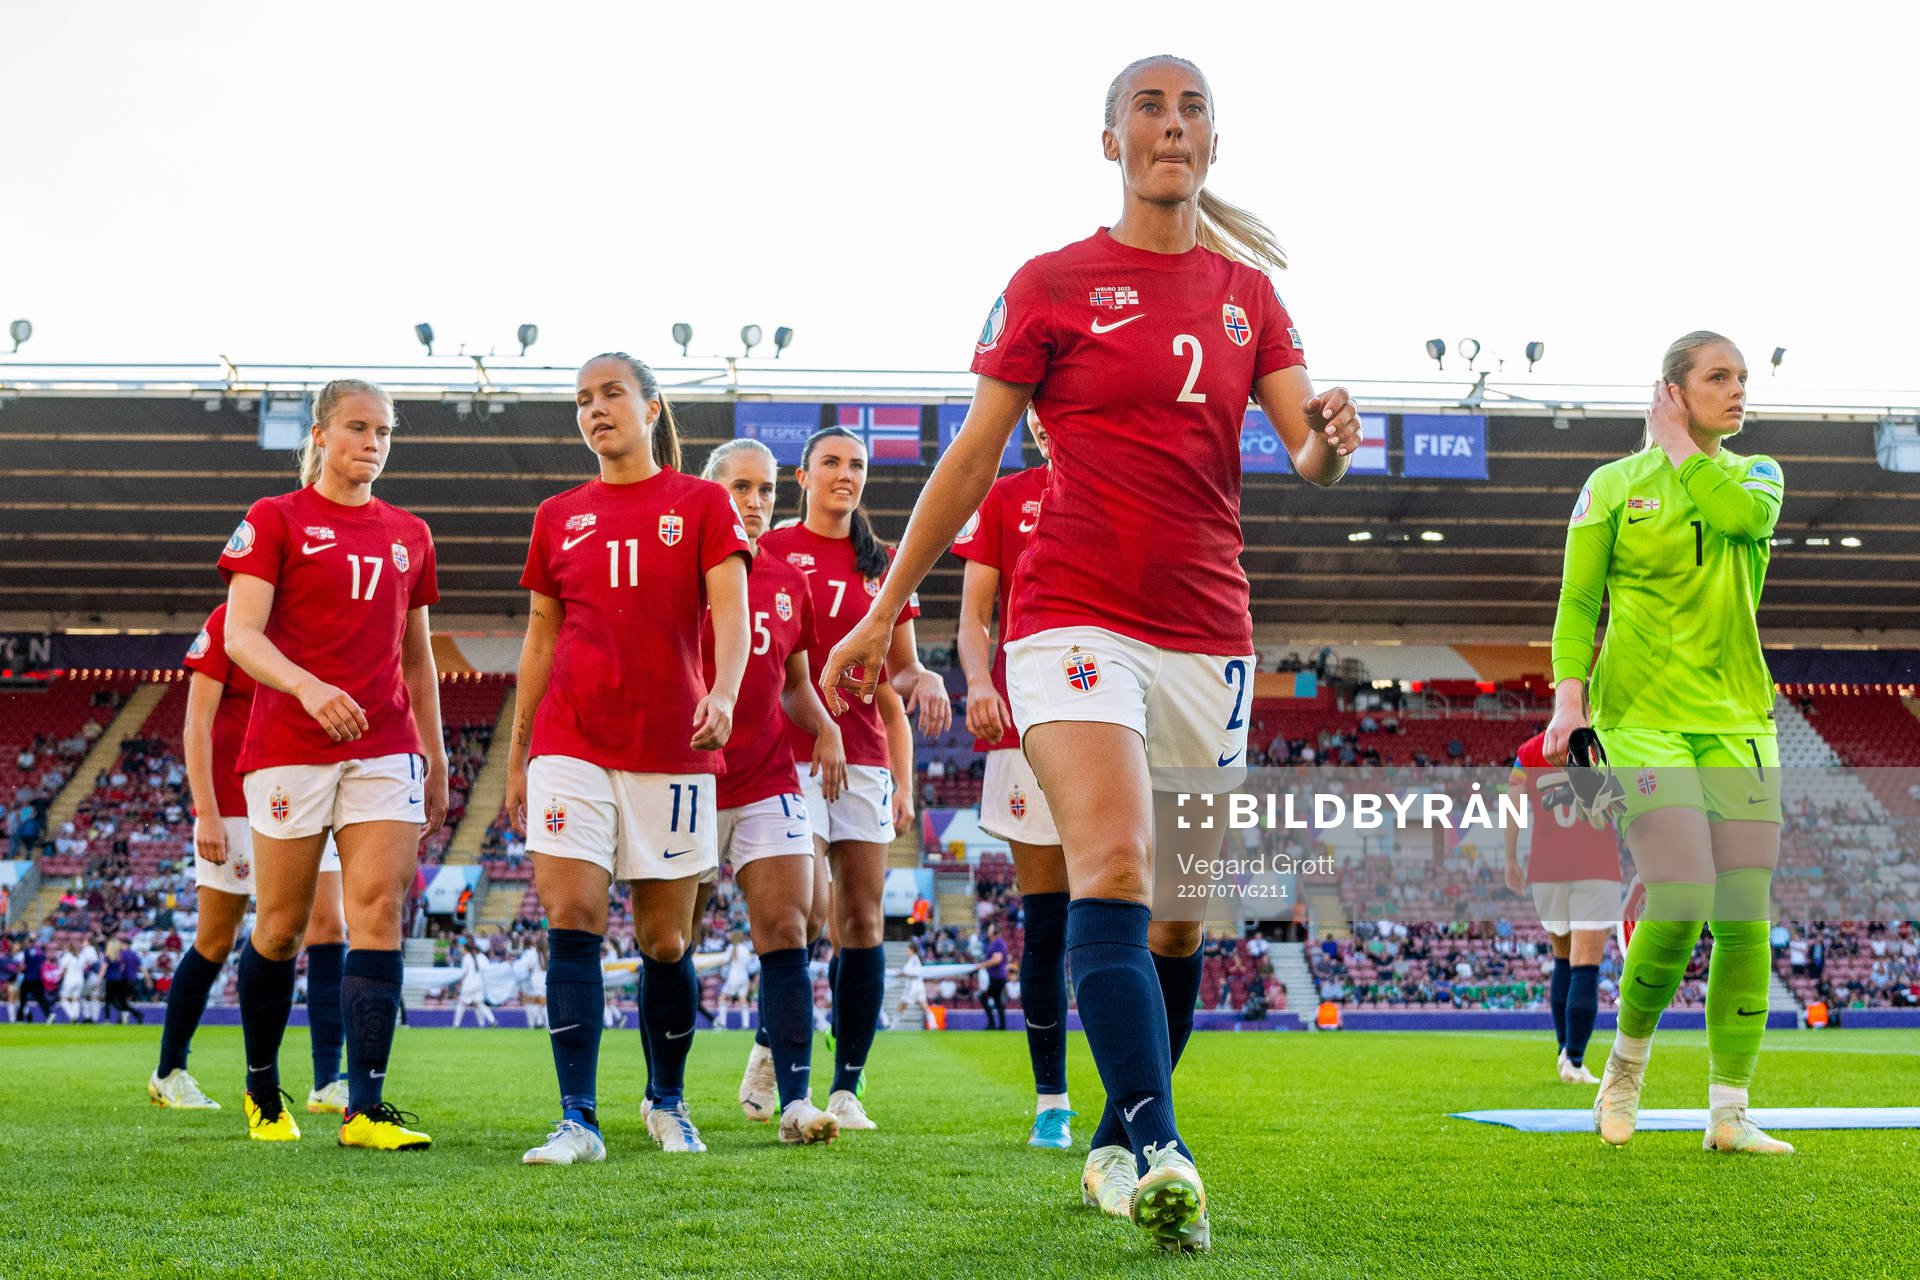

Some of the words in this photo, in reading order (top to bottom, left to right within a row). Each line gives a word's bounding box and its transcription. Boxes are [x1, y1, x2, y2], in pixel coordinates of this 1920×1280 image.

[1172, 334, 1207, 403] 2
[761, 427, 812, 440] RESPECT
[1414, 434, 1472, 457] FIFA
[606, 539, 638, 588] 11
[1690, 520, 1702, 566] 1
[347, 554, 383, 600] 17
[828, 580, 847, 618] 7
[753, 611, 771, 656] 5
[1225, 660, 1246, 731] 2
[1746, 738, 1765, 782] 1
[670, 783, 698, 833] 11
